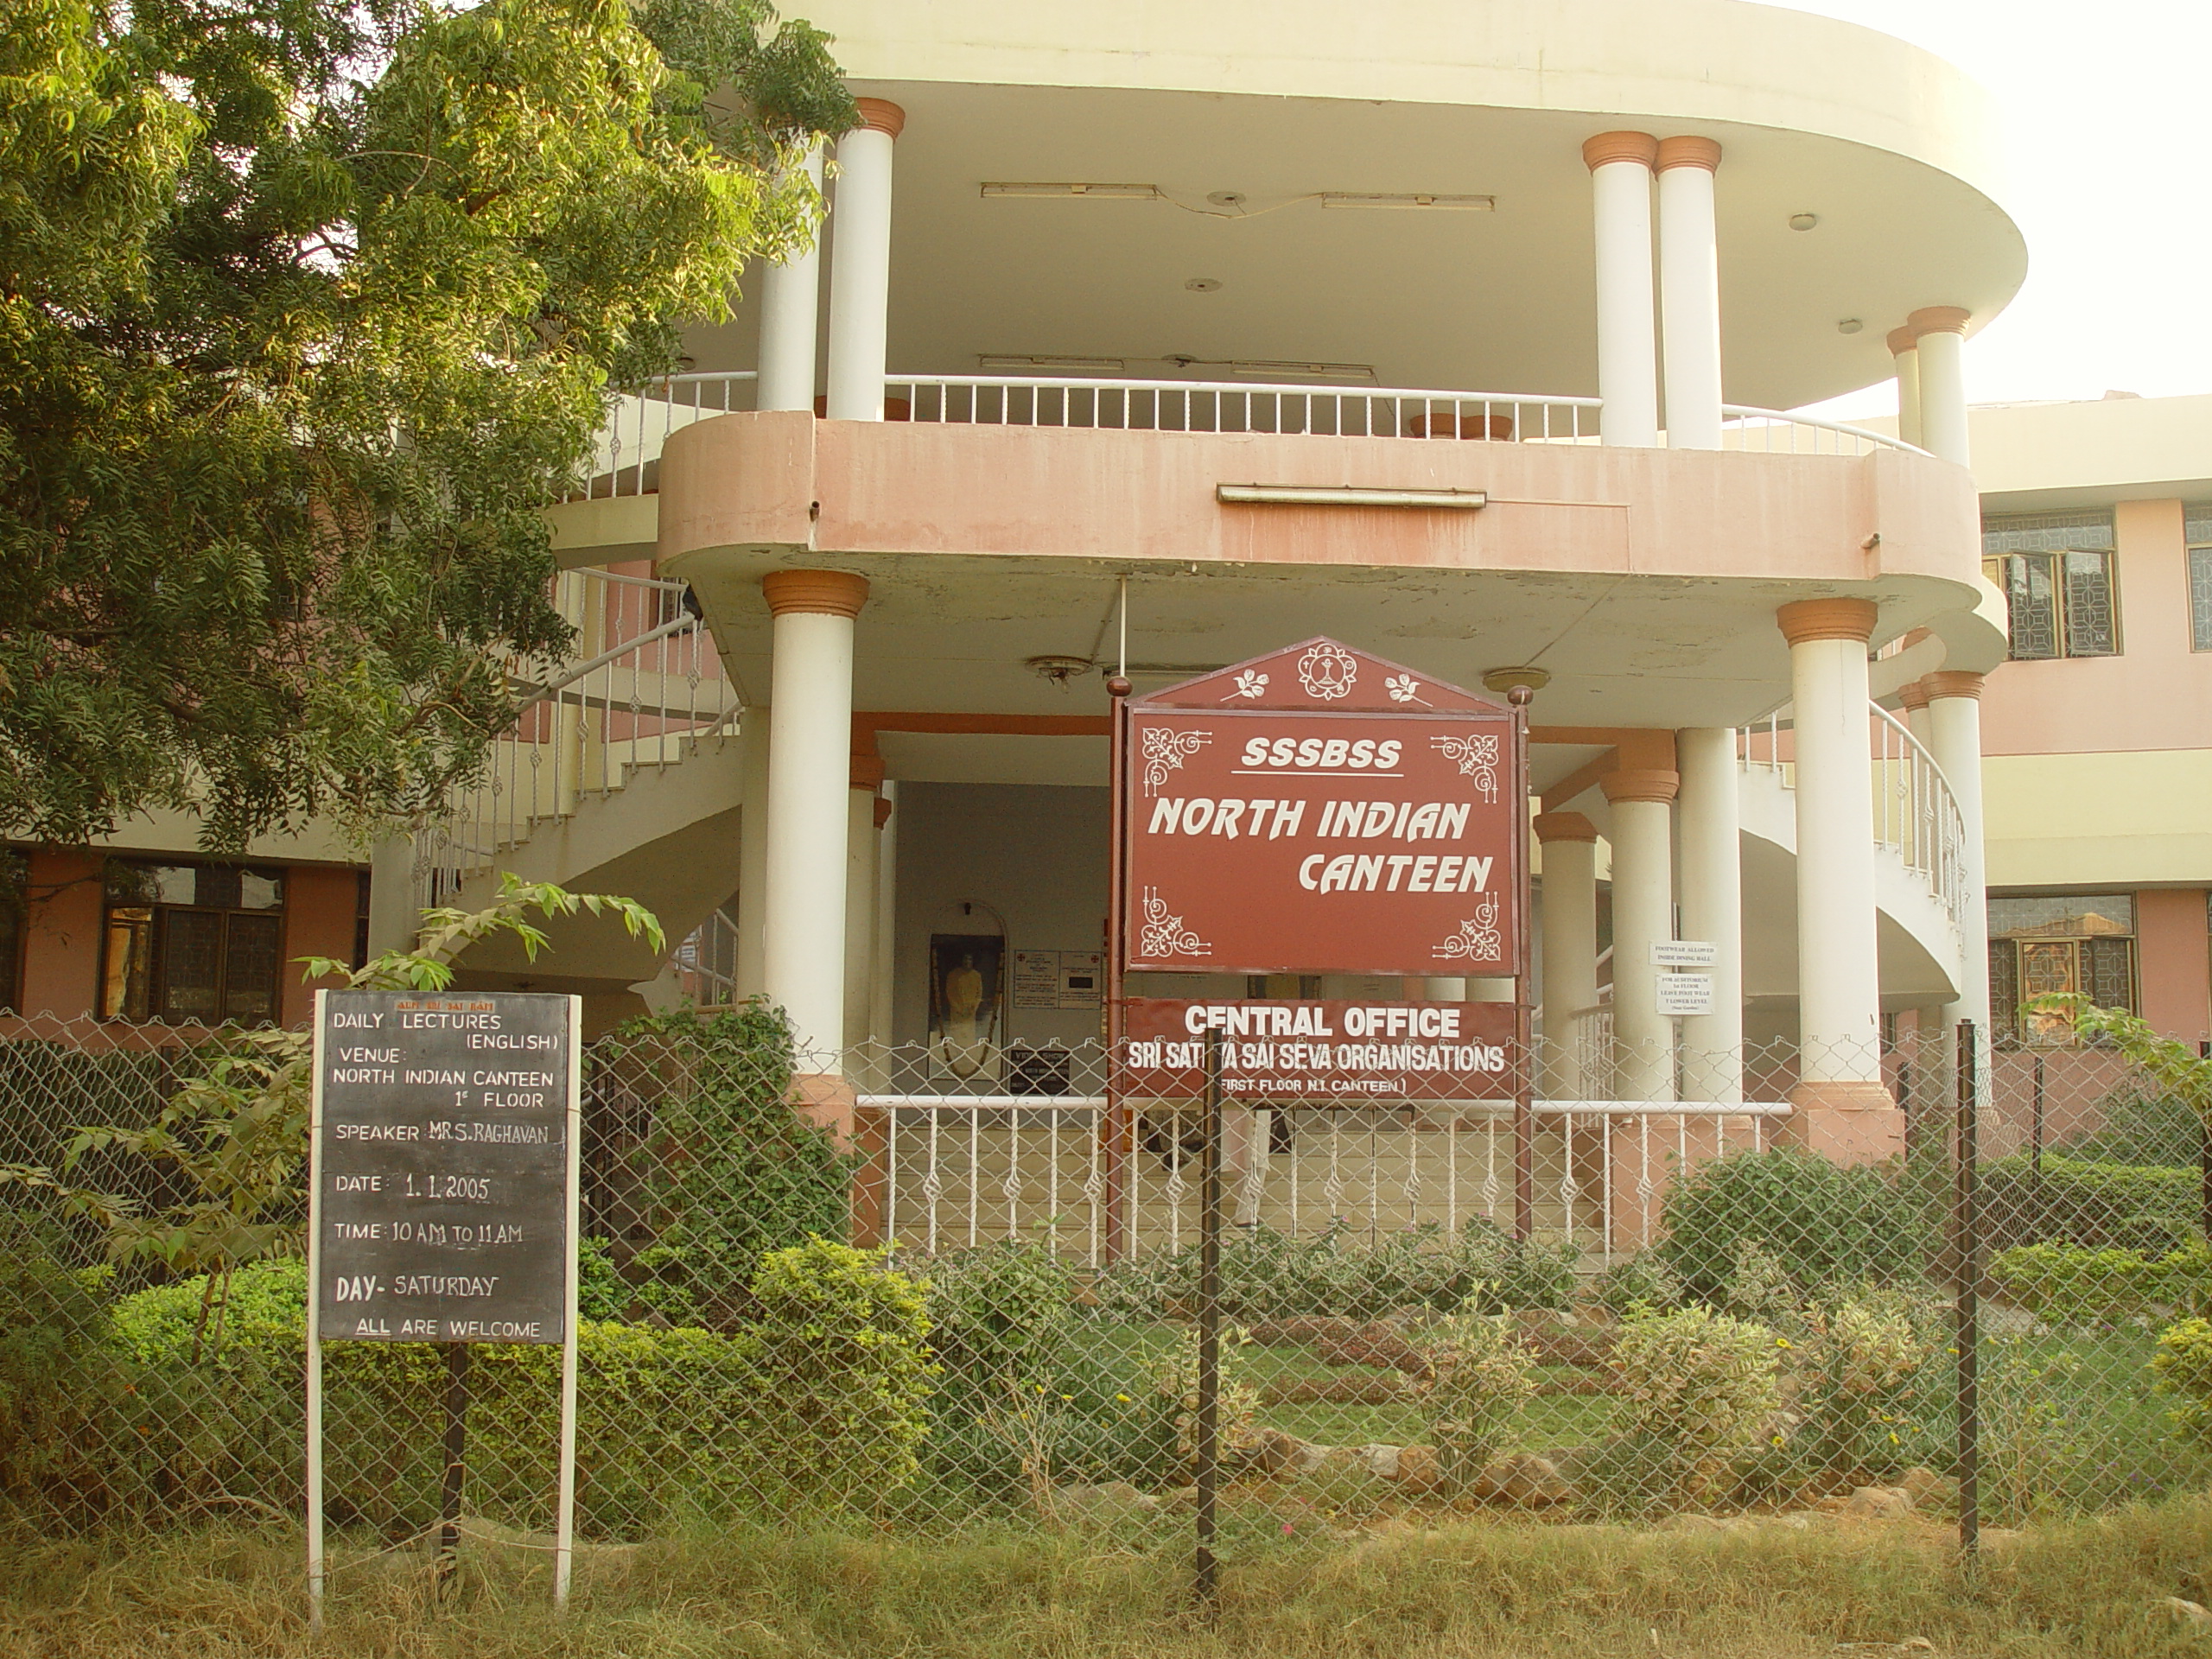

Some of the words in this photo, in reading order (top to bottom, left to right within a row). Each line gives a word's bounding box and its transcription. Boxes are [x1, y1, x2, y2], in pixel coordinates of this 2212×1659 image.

[1241, 737, 1403, 768] SSSBSS
[1147, 797, 1306, 842] NORTH
[1316, 801, 1471, 843] INDIAN
[1298, 854, 1494, 894] CANTEEN
[334, 1012, 385, 1028] DAILY
[403, 1014, 501, 1030] LECTURES
[1185, 1006, 1332, 1036] CENTRAL
[1344, 1008, 1460, 1038] OFFICE
[467, 1034, 558, 1050] (ENGLISH)
[1128, 1041, 1160, 1068] SRI
[1242, 1043, 1274, 1069] SAI
[1280, 1043, 1332, 1070] SEVA
[1337, 1044, 1504, 1071] ORGANISATIONS
[334, 1069, 394, 1084] NORTH
[405, 1070, 465, 1084] INDIAN
[474, 1071, 554, 1086] CANTEEN
[1259, 1079, 1302, 1091] FLOOR
[484, 1092, 543, 1108] FLOOR
[392, 1221, 412, 1242] 10
[416, 1223, 447, 1245] AM
[452, 1225, 473, 1242] TO
[394, 1274, 500, 1297] SATURDAY
[355, 1318, 391, 1336] ALL
[401, 1319, 438, 1335] ARE
[450, 1320, 541, 1338] WELCOME
